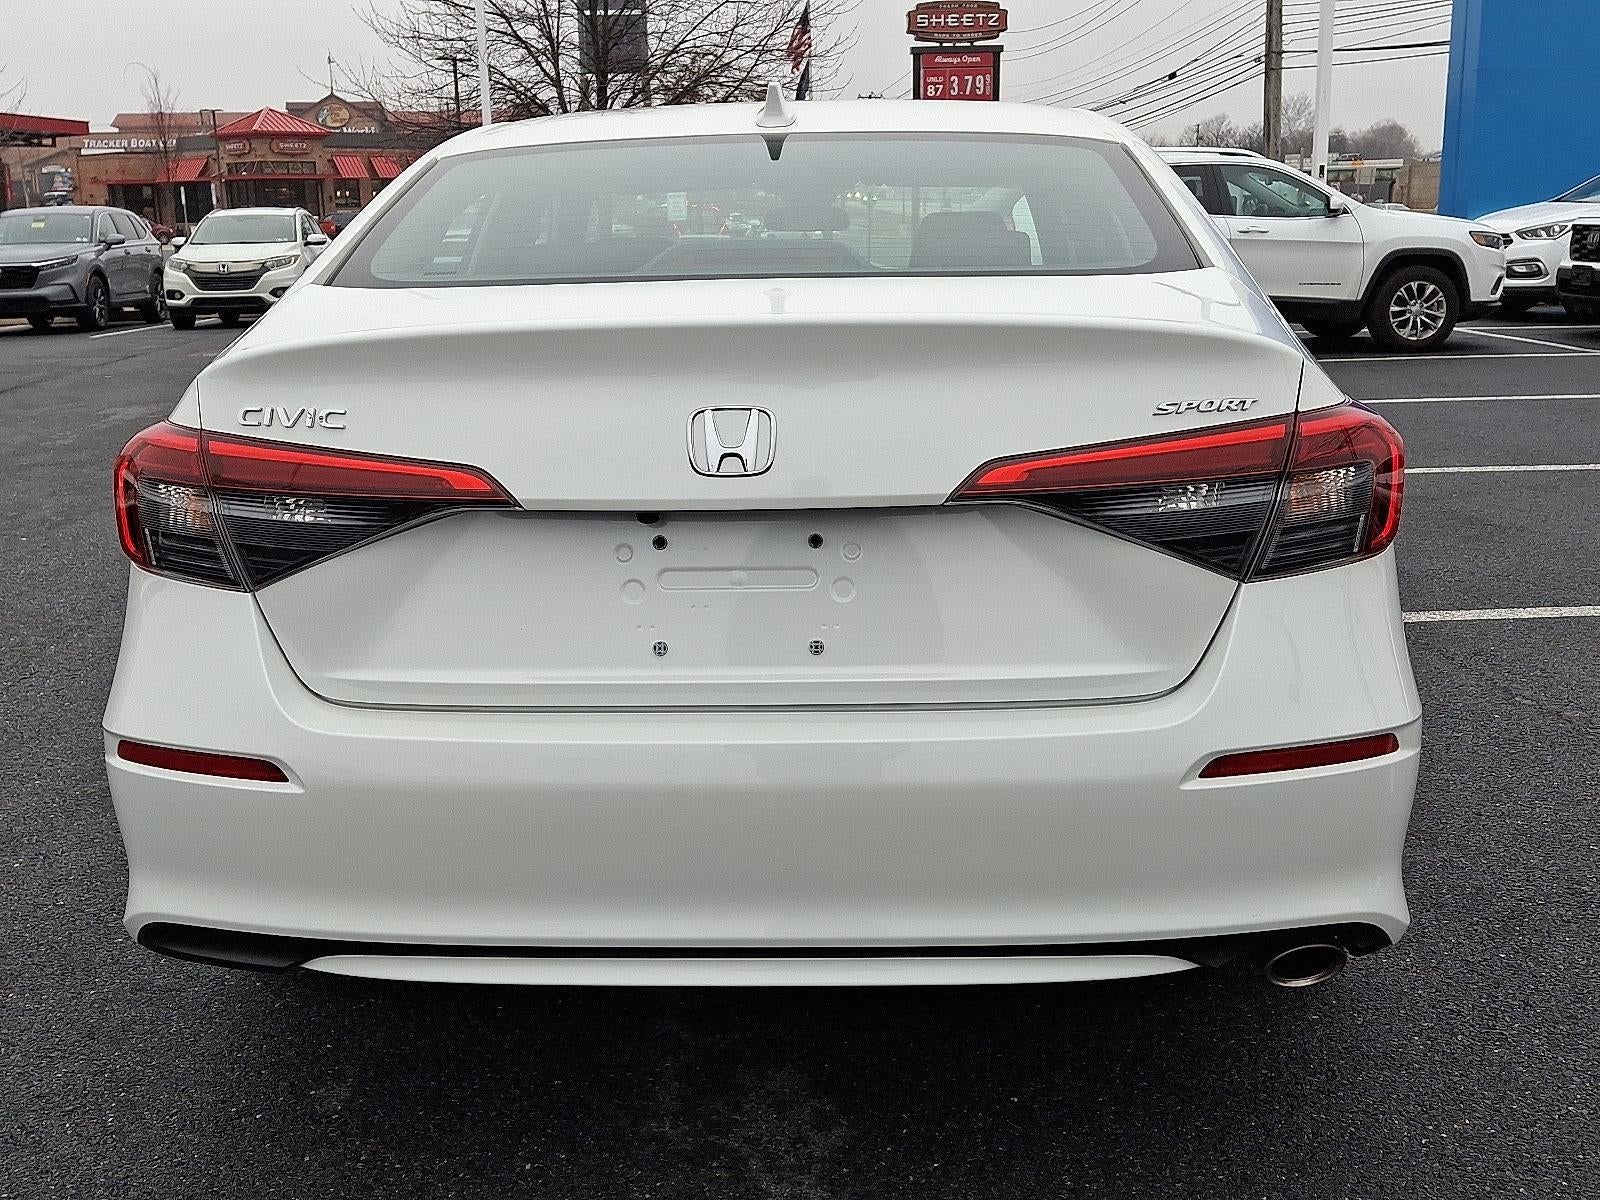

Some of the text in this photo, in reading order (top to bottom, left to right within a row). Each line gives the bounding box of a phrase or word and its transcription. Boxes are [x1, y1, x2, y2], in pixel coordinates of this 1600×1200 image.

[916, 13, 1000, 27] SHEETZ
[934, 55, 981, 64] Always Open
[926, 84, 944, 97] 87
[83, 139, 128, 148] TRACKER
[130, 138, 157, 148] BOAT
[1152, 398, 1258, 416] SPORT
[238, 406, 347, 430] CIVIC
